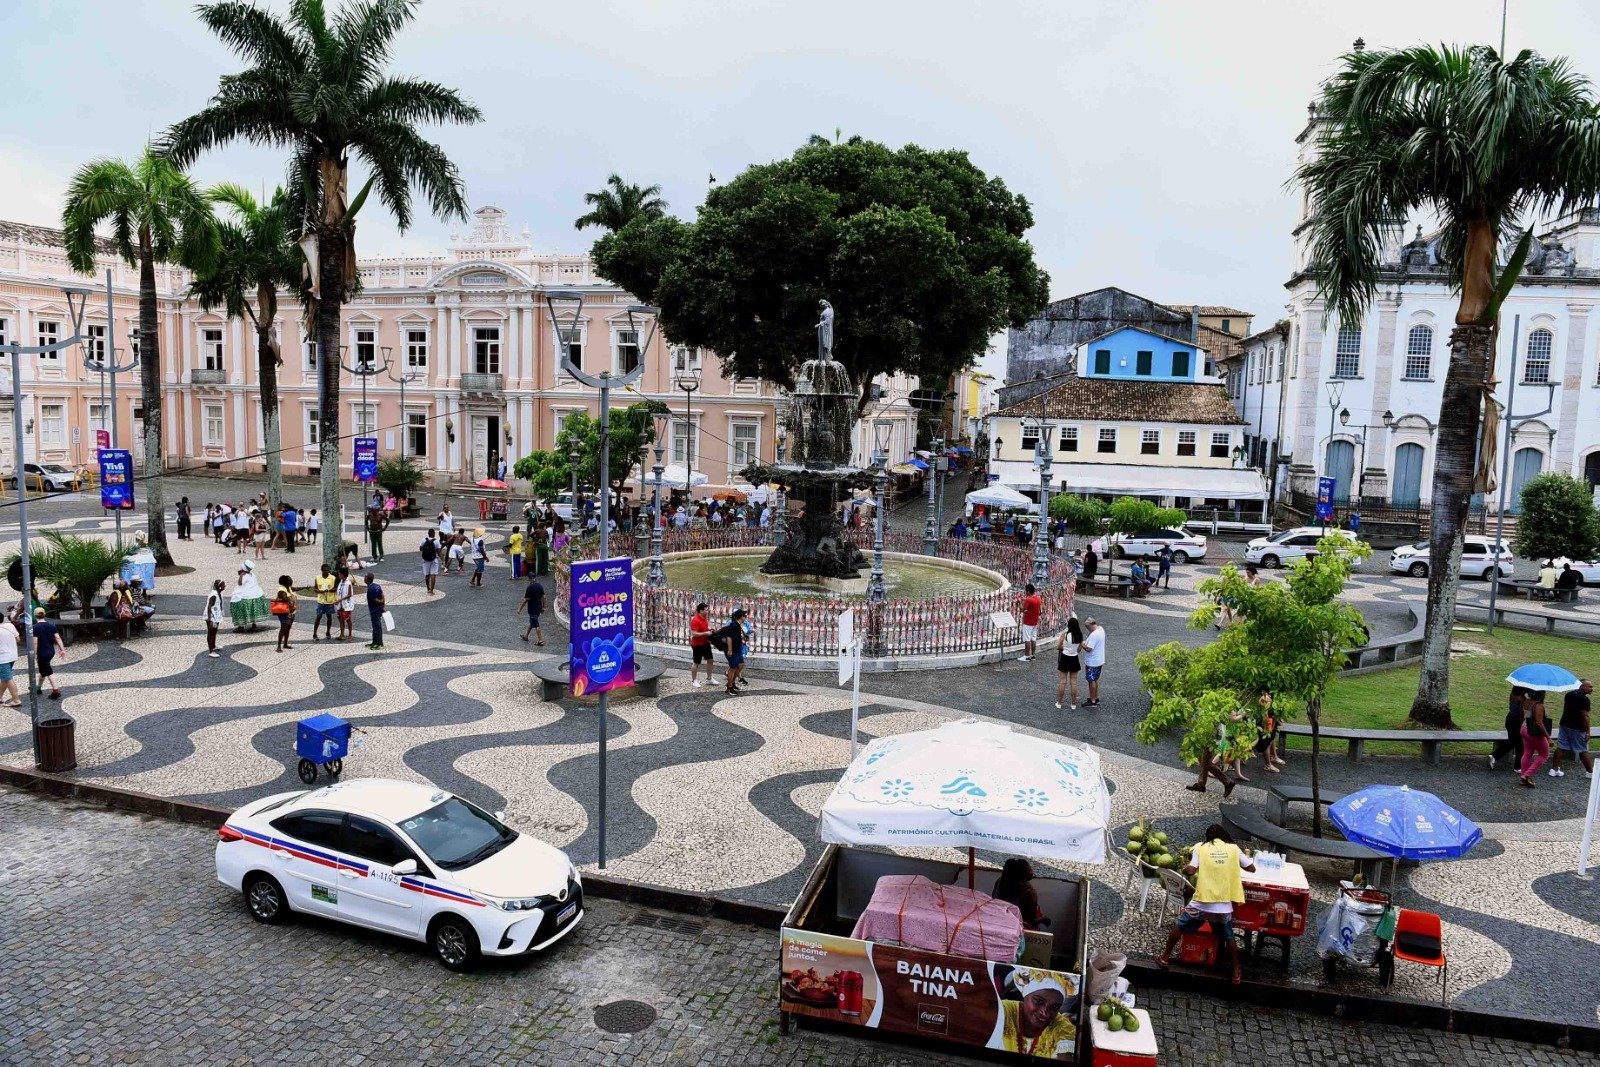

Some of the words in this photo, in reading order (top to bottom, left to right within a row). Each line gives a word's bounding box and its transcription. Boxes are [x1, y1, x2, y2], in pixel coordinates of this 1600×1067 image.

[578, 591, 628, 607] Celebre
[584, 603, 623, 617] nossa
[581, 613, 626, 630] cidade
[974, 831, 1013, 841] IMATERIAL
[1027, 837, 1056, 846] BRASIL
[797, 940, 823, 949] magia
[801, 947, 828, 957] comer
[788, 951, 817, 961] juntos.
[896, 960, 974, 985] BAIANA
[909, 978, 958, 999] TINA
